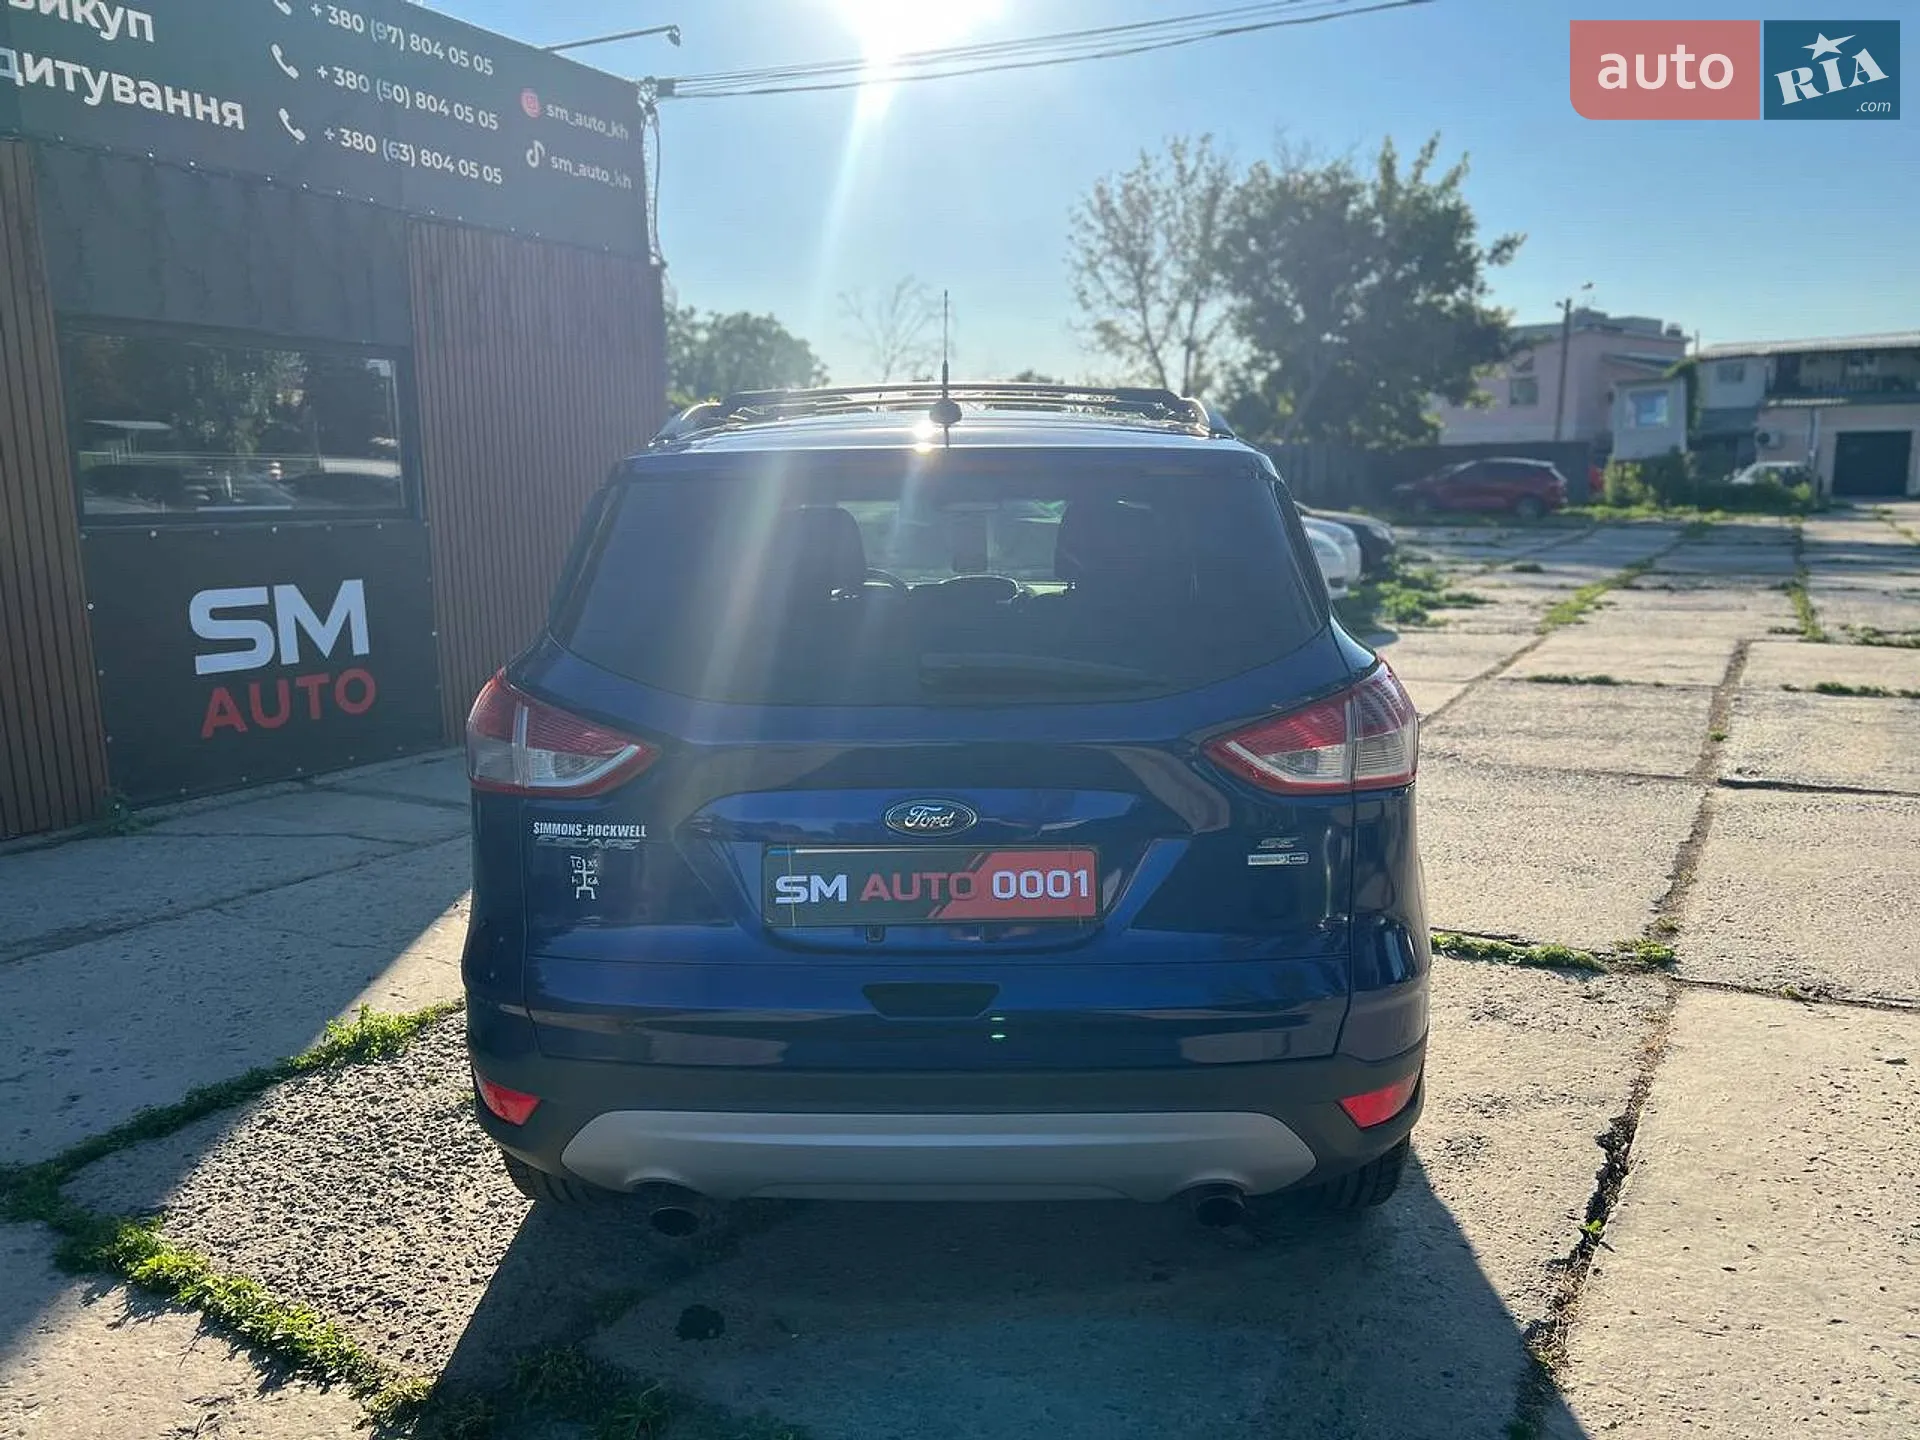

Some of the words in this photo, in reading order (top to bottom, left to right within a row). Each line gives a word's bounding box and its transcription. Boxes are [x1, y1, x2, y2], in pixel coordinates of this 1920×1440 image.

[327, 5, 364, 33] 380
[370, 18, 405, 51] (97)
[410, 33, 445, 60] 804
[449, 46, 470, 68] 05
[473, 55, 494, 76] 05
[333, 66, 370, 93] 380
[376, 78, 411, 109] (50)
[415, 91, 450, 117] 804
[454, 103, 475, 124] 05
[478, 110, 499, 131] 05
[546, 103, 629, 140] sm_auto_kh
[339, 128, 377, 154] 380
[382, 138, 416, 168] (63)
[420, 149, 455, 174] 804
[458, 159, 479, 179] 05
[483, 165, 503, 185] 05
[551, 156, 632, 189] sm_auto_kh
[189, 579, 370, 675] SM
[201, 667, 377, 739] AUTO
[533, 822, 648, 838] SIMMONS-ROCKWELL
[904, 805, 955, 829] Ford
[775, 873, 848, 904] SM
[860, 871, 978, 901] AUTO
[992, 869, 1089, 900] 0001
